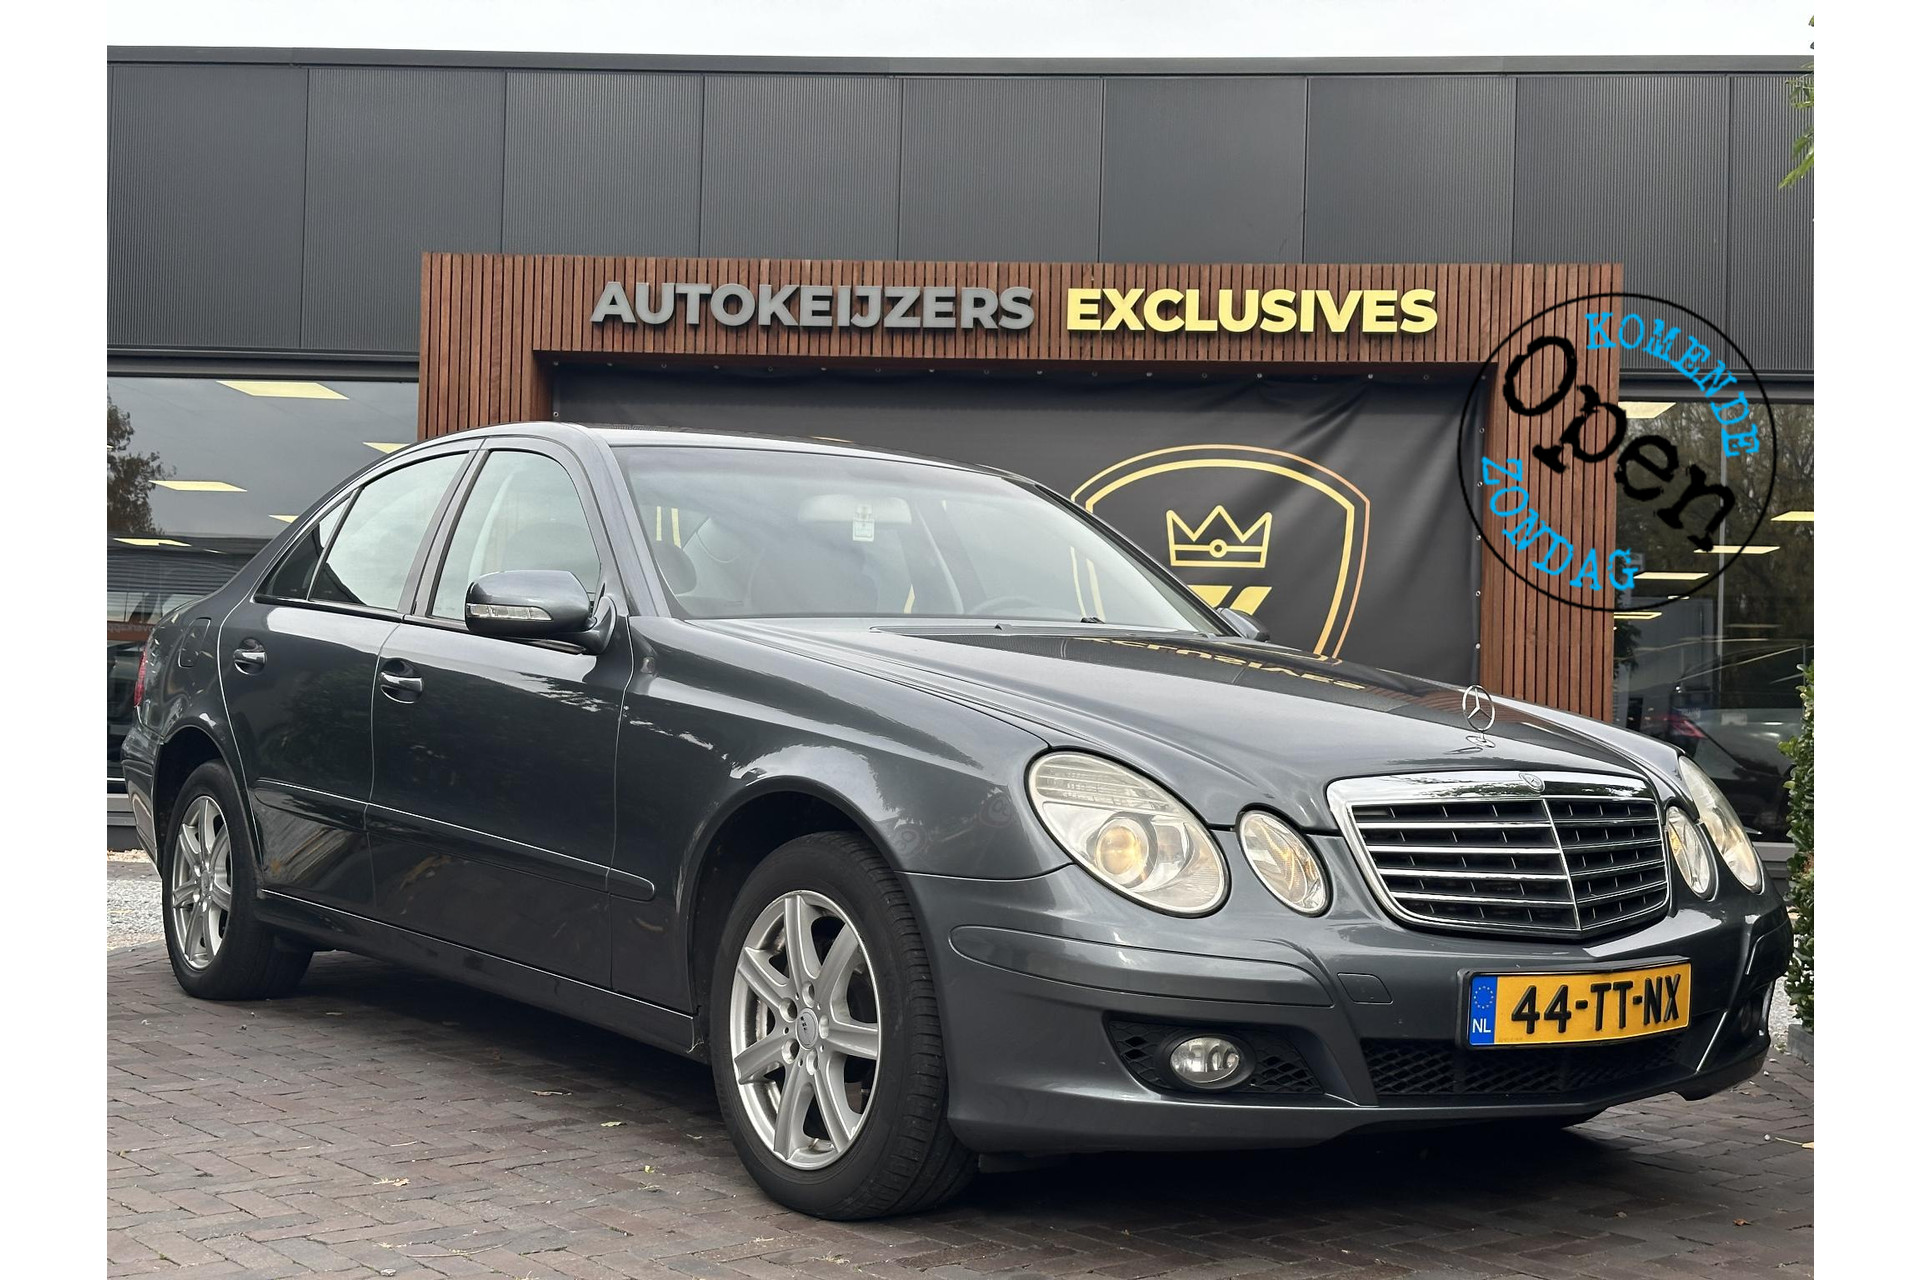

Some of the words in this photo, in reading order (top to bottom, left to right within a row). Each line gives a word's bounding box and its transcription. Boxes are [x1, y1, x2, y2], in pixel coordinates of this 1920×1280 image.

[590, 281, 1035, 330] AUTOKEIJZERS
[1067, 288, 1438, 333] EXCLUSIVES
[1472, 1018, 1491, 1033] NL
[1511, 973, 1681, 1034] 44-TT-NX
